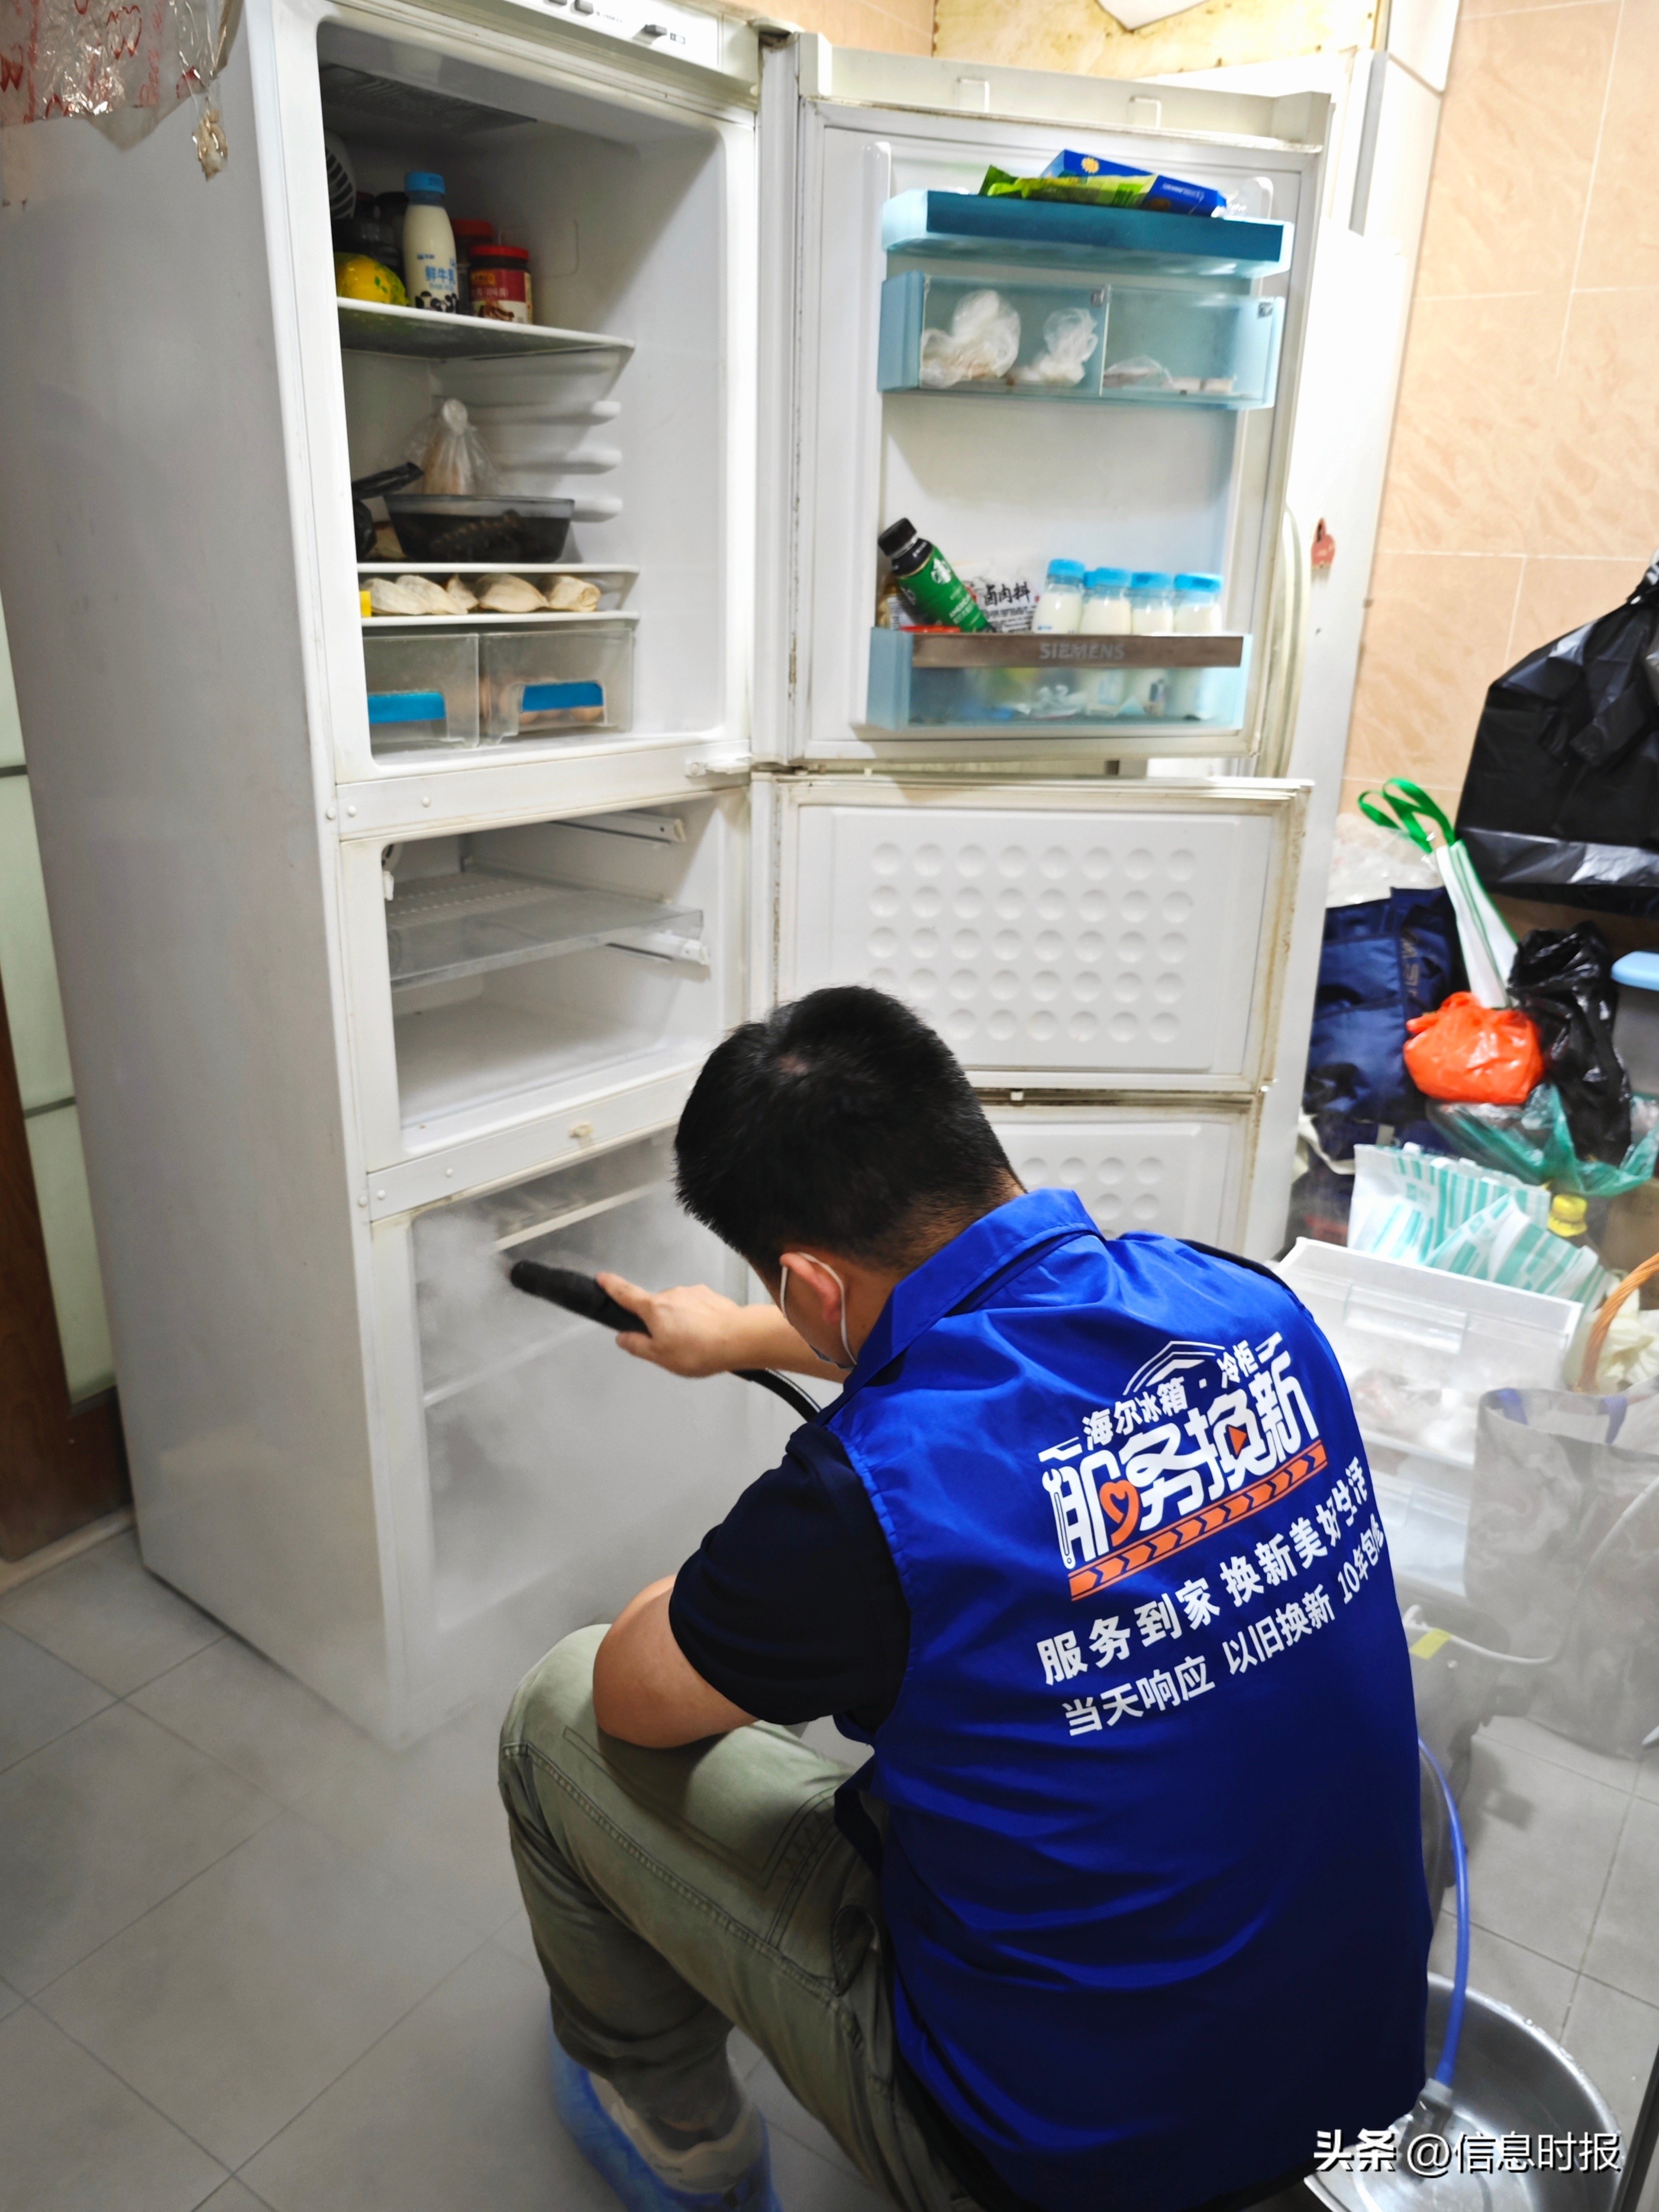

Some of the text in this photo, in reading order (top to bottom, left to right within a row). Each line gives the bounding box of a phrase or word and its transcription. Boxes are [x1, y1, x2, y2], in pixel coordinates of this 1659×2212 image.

[1040, 642, 1125, 660] SIEMENS
[1037, 1456, 1367, 1685] 服务到家 换新美好生活
[1062, 1655, 1215, 1737] 当天响应
[1222, 1585, 1334, 1675] 以旧换新
